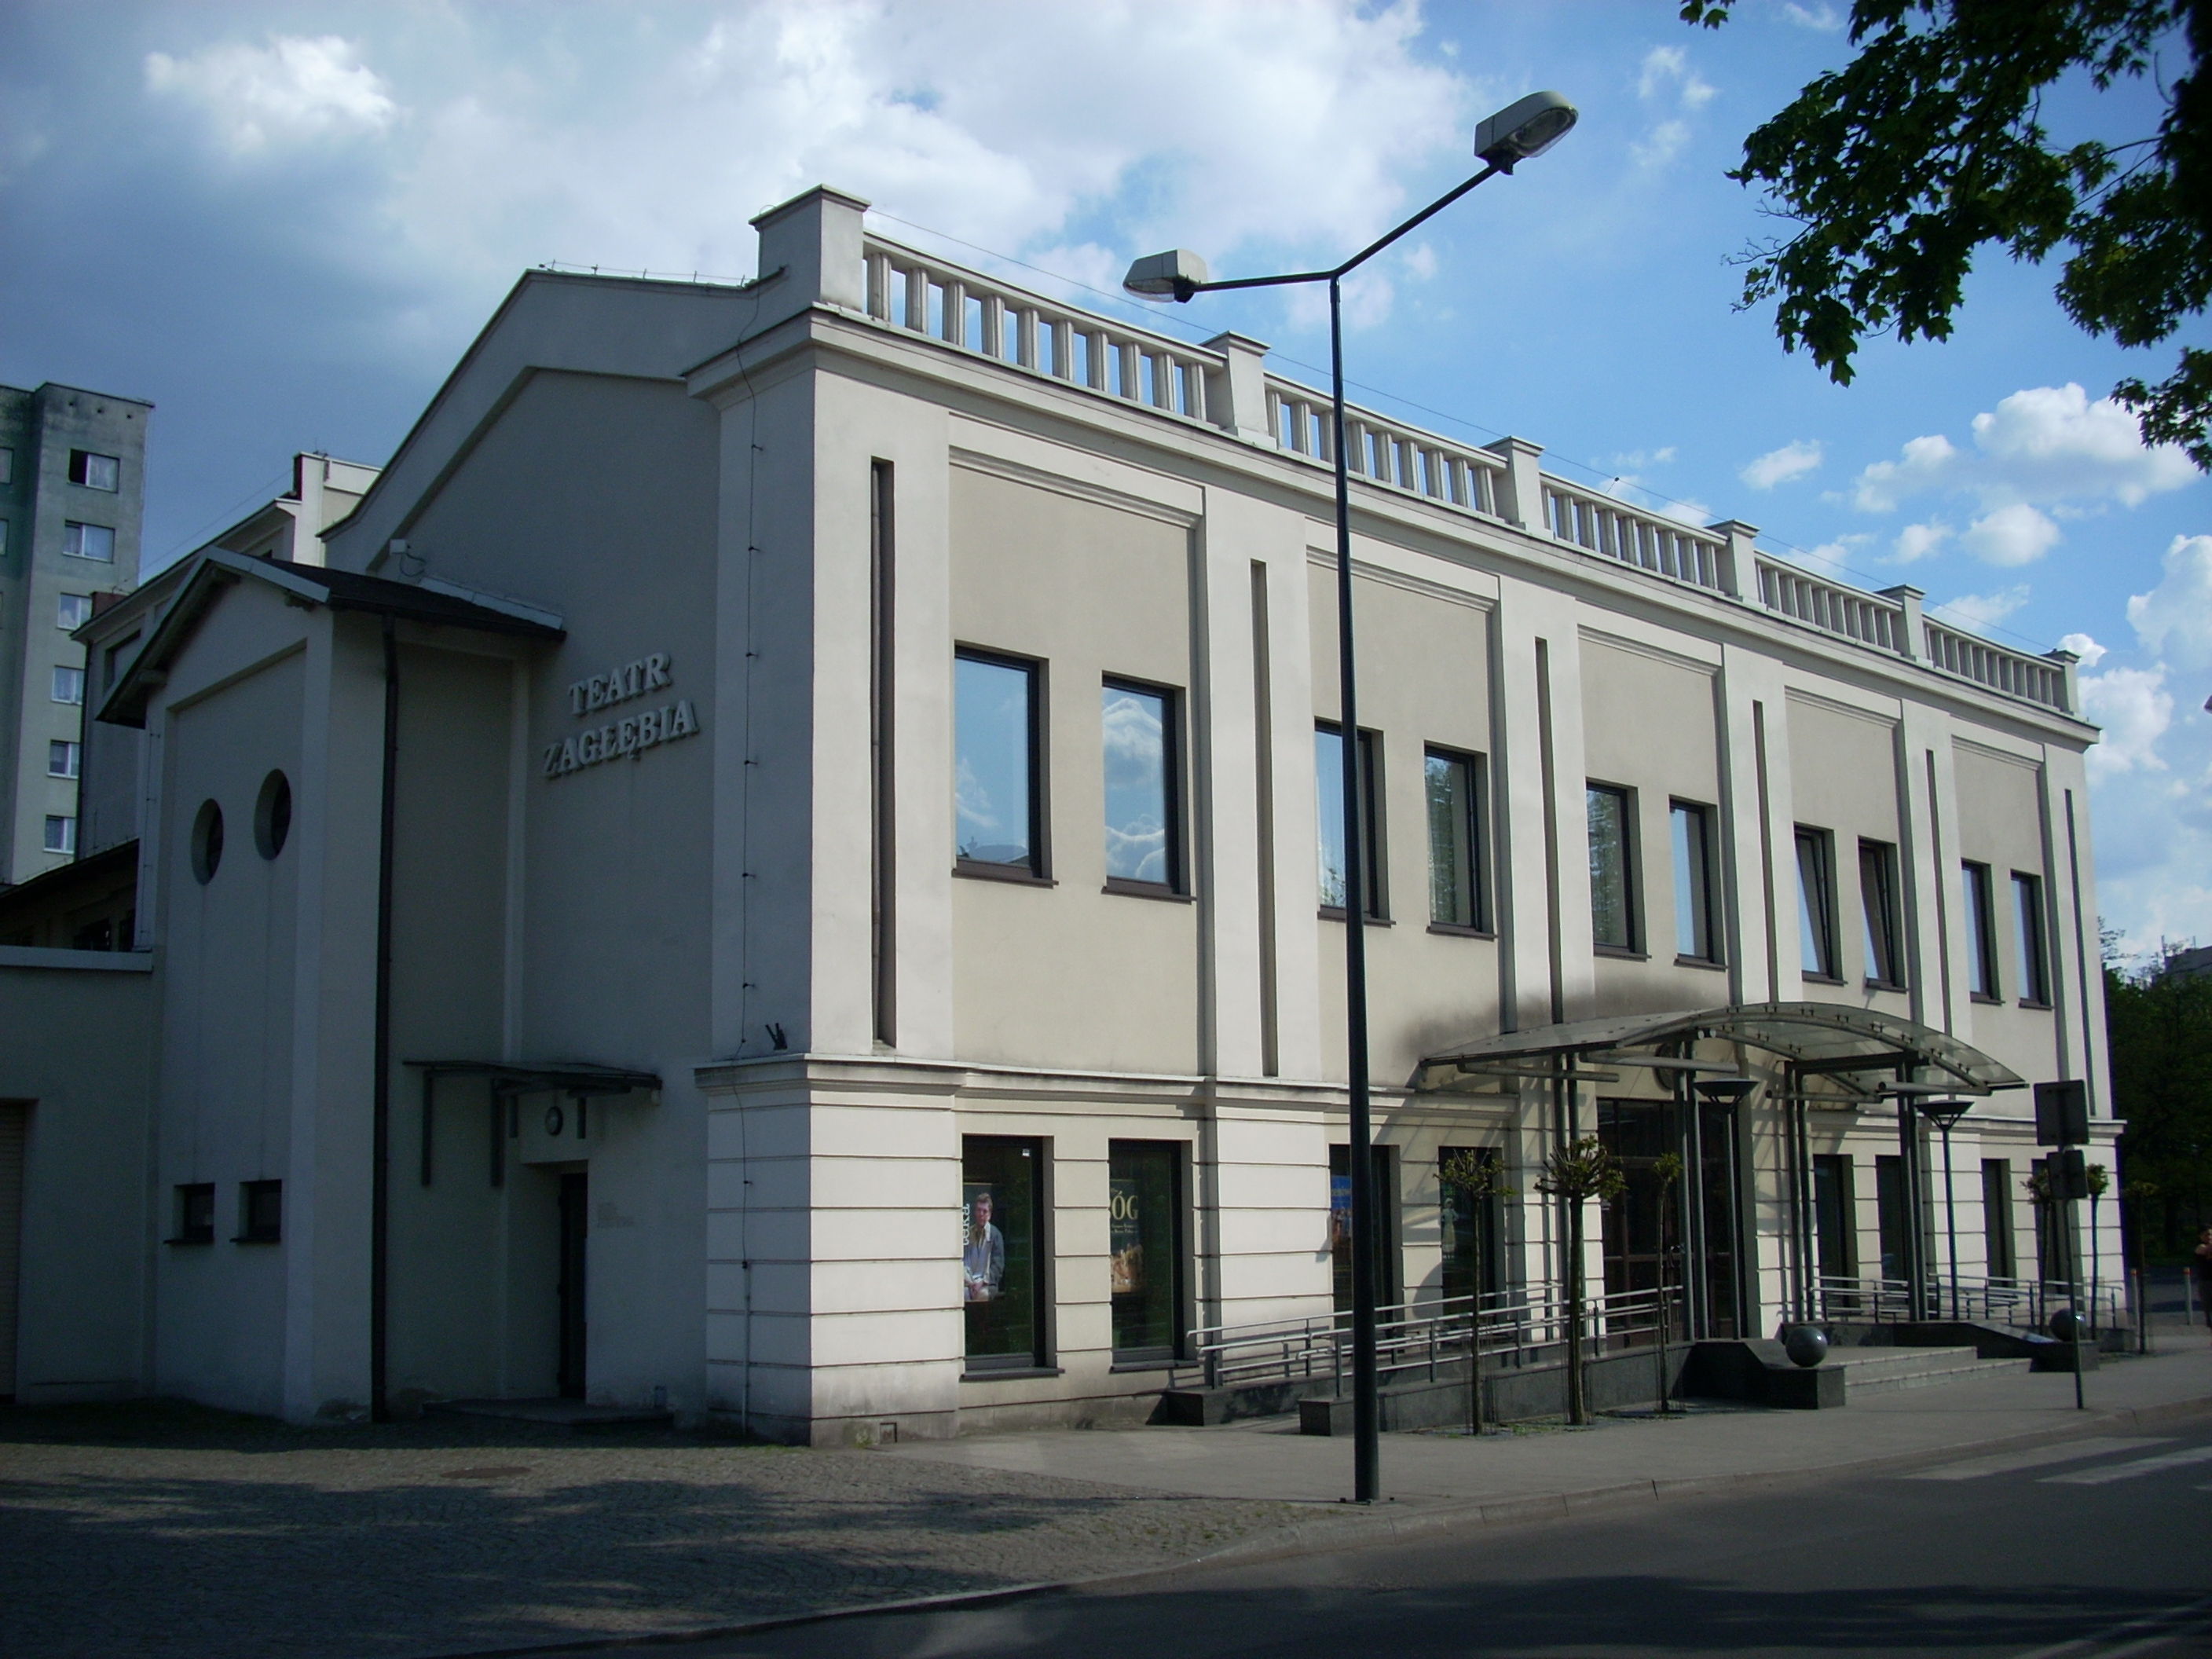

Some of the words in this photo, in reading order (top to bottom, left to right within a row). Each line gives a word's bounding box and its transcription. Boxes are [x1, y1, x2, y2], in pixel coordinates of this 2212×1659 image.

[568, 652, 672, 716] TEATR
[542, 698, 699, 778] ZAGŁĘBIA
[1109, 1190, 1138, 1220] ÓG
